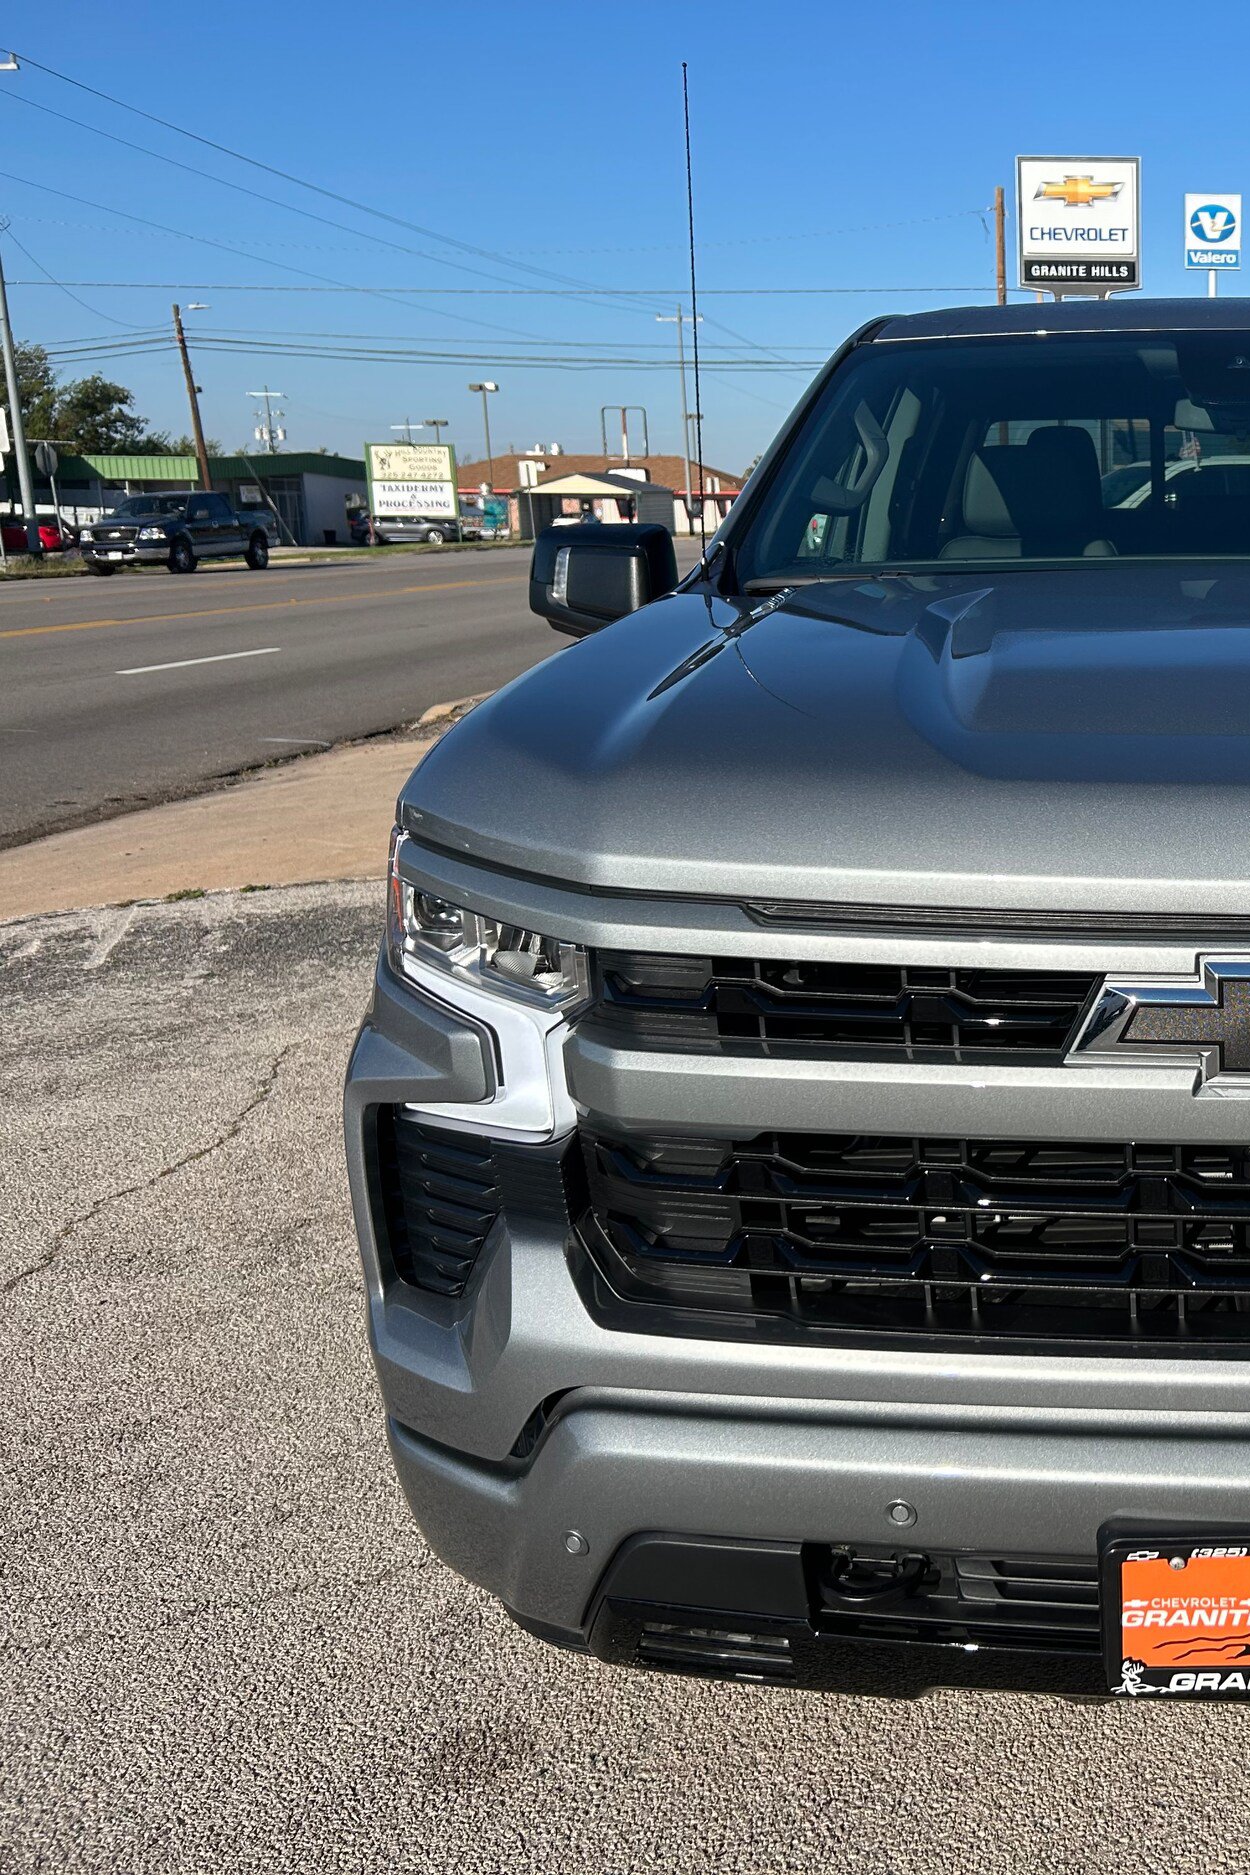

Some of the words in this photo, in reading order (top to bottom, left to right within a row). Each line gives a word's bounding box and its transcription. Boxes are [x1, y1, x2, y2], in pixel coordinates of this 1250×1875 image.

[1029, 227, 1129, 242] CHEVROLET
[1189, 251, 1237, 264] Valero
[1031, 264, 1087, 277] GRANITE
[1091, 265, 1129, 278] HILLS
[380, 484, 445, 492] TAXIDERMY
[378, 500, 450, 508] PROCESSING
[1190, 1547, 1248, 1558] (325)
[1151, 1597, 1237, 1609] CHEVROLET
